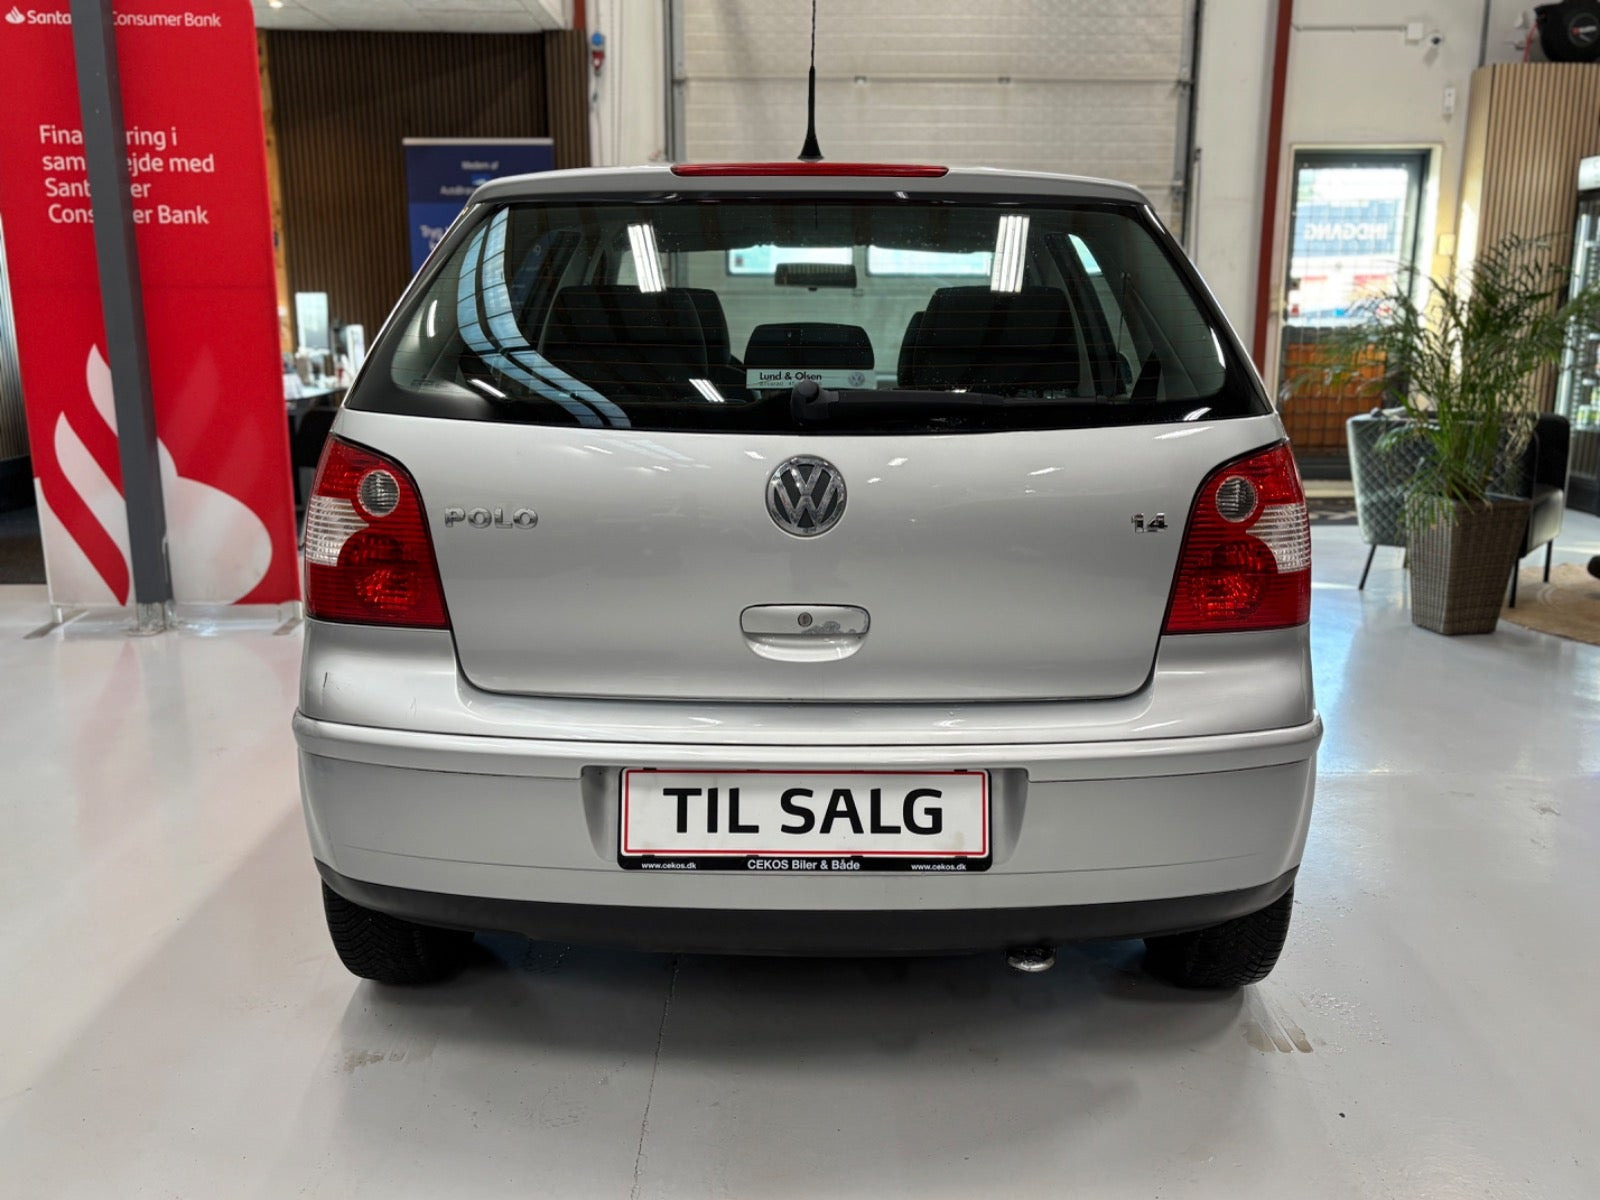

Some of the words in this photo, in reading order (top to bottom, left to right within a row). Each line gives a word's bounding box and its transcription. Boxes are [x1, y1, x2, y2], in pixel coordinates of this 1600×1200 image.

[184, 12, 221, 27] Bank
[39, 125, 167, 151] Finaring
[171, 127, 177, 146] i
[42, 153, 163, 176] samjde
[169, 154, 215, 173] med
[45, 178, 151, 198] Santer
[48, 204, 153, 224] Conser
[158, 205, 209, 225] Bank
[759, 372, 782, 381] Lund
[784, 372, 792, 381] &
[794, 372, 822, 381] Olsen
[444, 507, 539, 530] POLO
[662, 787, 760, 834] TIL
[780, 787, 943, 836] SALG
[641, 860, 697, 870] www.cekos.dk
[747, 858, 789, 871] CEKOS
[791, 858, 818, 870] Biler
[819, 859, 829, 871] &
[831, 858, 861, 871] Både
[910, 862, 967, 872] www.cekos.dk
